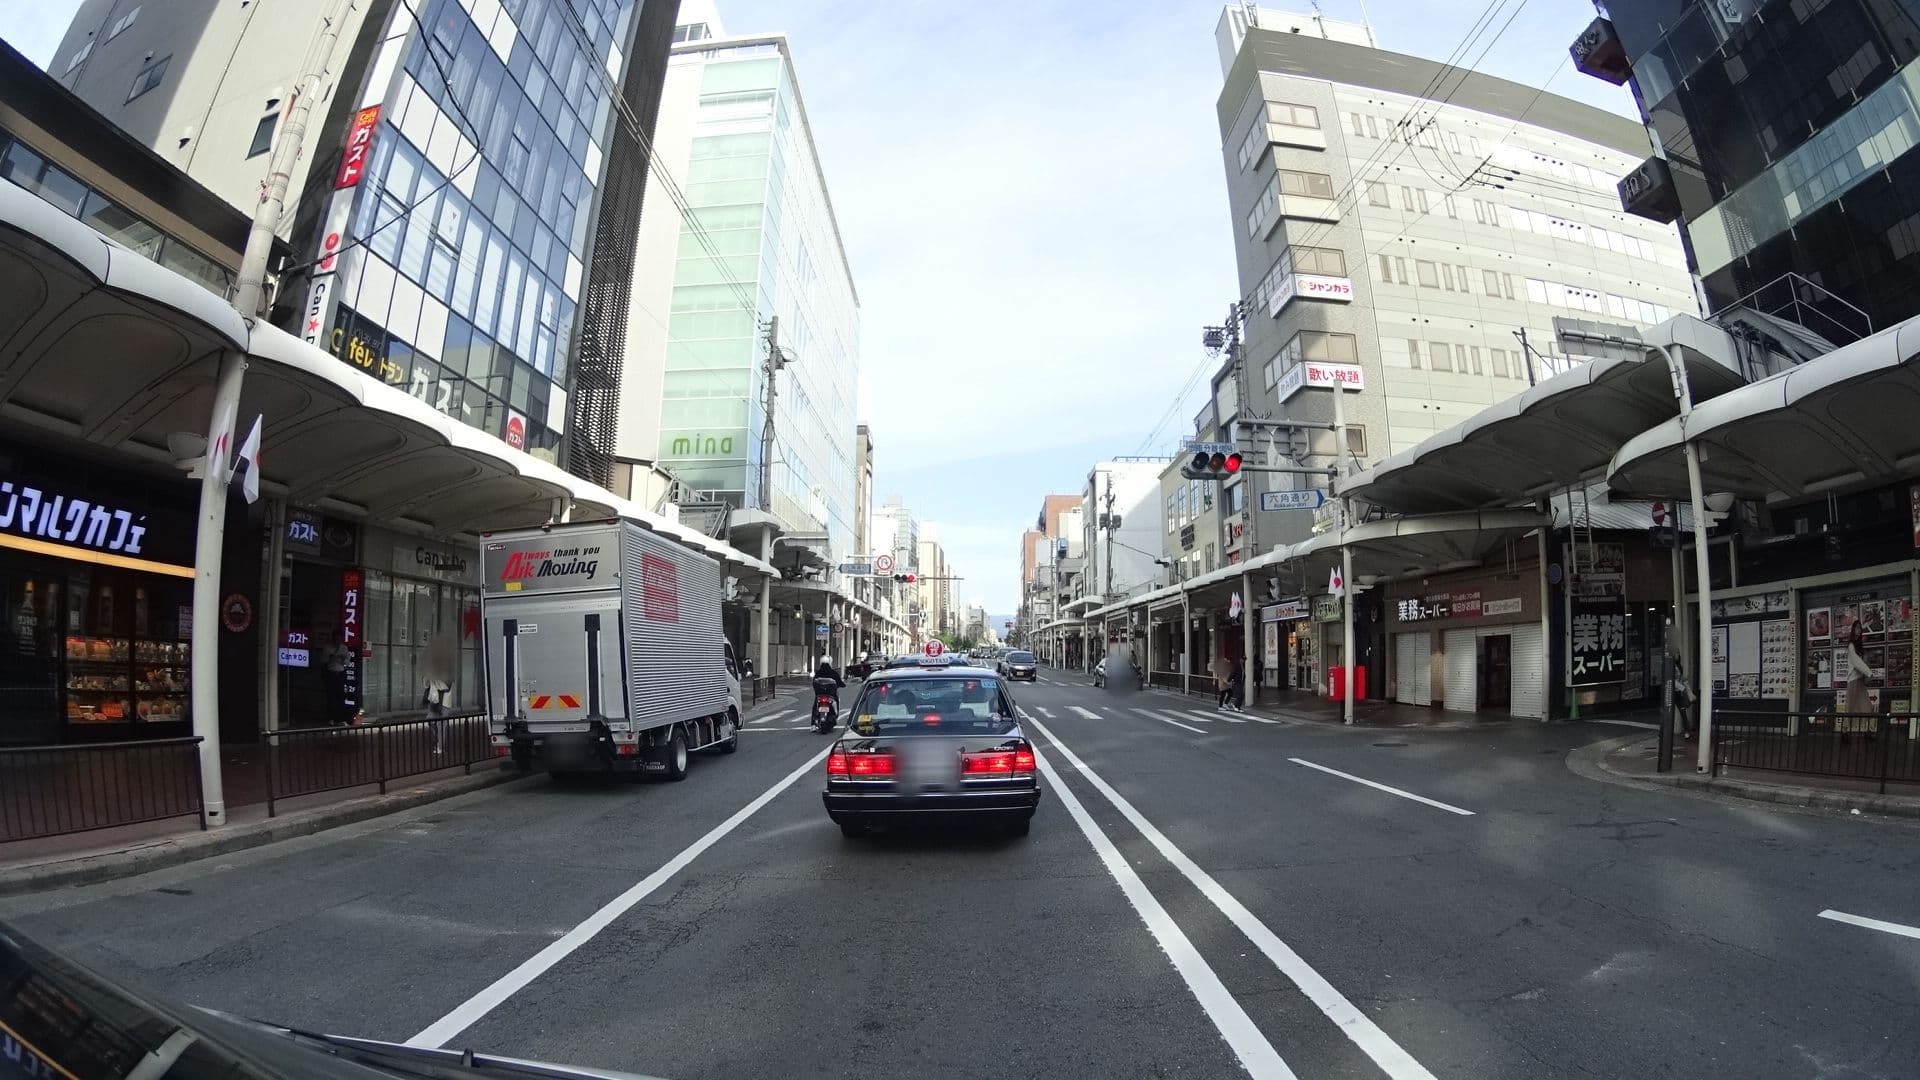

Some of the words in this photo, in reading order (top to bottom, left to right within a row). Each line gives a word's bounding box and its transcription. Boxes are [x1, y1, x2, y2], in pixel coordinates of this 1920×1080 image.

[343, 125, 372, 183] ガスト
[1309, 367, 1360, 384] 歌い放題
[672, 433, 733, 455] mina
[1269, 492, 1310, 503] 六角通り
[289, 520, 319, 542] ガスト
[416, 546, 439, 566] Can
[554, 548, 579, 558] thank
[583, 546, 600, 556] you
[537, 558, 598, 580] Moving
[345, 589, 358, 643] ガスト
[1398, 598, 1447, 622] 業務スーパー
[288, 632, 309, 645] ガスト
[1572, 613, 1625, 653] 業務
[1572, 652, 1625, 676] スーパー
